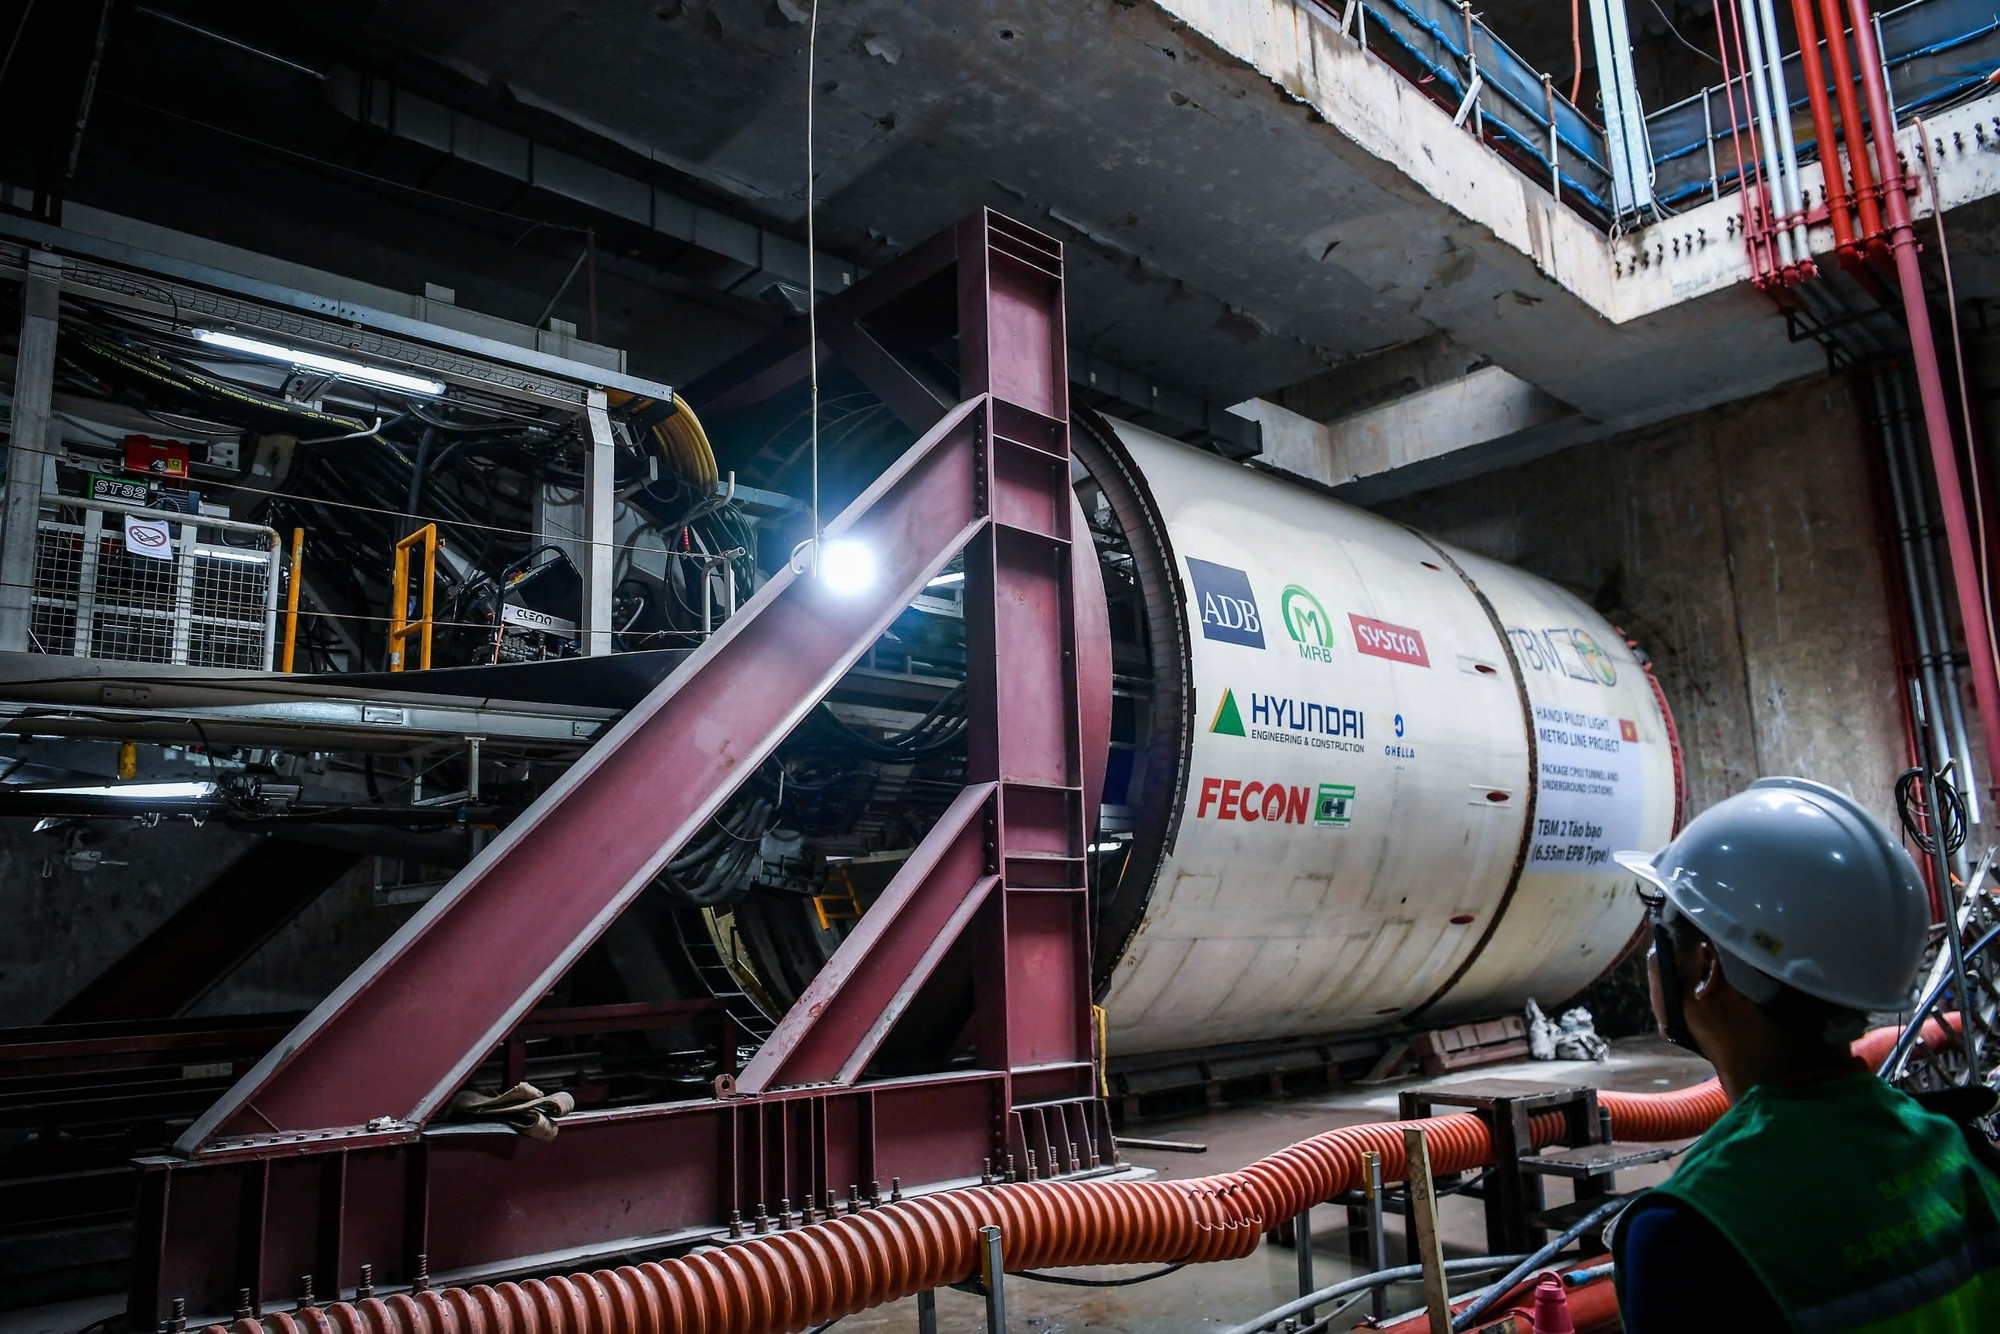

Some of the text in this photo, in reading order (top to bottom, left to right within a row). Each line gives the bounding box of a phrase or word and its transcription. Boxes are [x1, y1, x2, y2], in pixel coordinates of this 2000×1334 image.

[94, 480, 147, 500] ST32
[1202, 591, 1260, 633] ADB
[1358, 624, 1421, 658] SYSTRA
[1299, 644, 1333, 663] MRB
[1252, 693, 1365, 739] HYUNDAI
[1536, 706, 1610, 731] HANOI PILOT LIGHT
[1252, 729, 1365, 754] ENGINEERING & CONSTRUCTION
[1384, 745, 1416, 759] GHELLA
[1539, 728, 1620, 753] METRO LINE PROJECT
[1542, 763, 1569, 776] PACKAGE
[1542, 779, 1614, 796] UNDERGROUND STATIONS
[1197, 777, 1311, 825] FECON
[1538, 819, 1559, 837] TBM
[1560, 821, 1567, 837] 2
[1531, 844, 1610, 866] (6.55m EPB Type)
